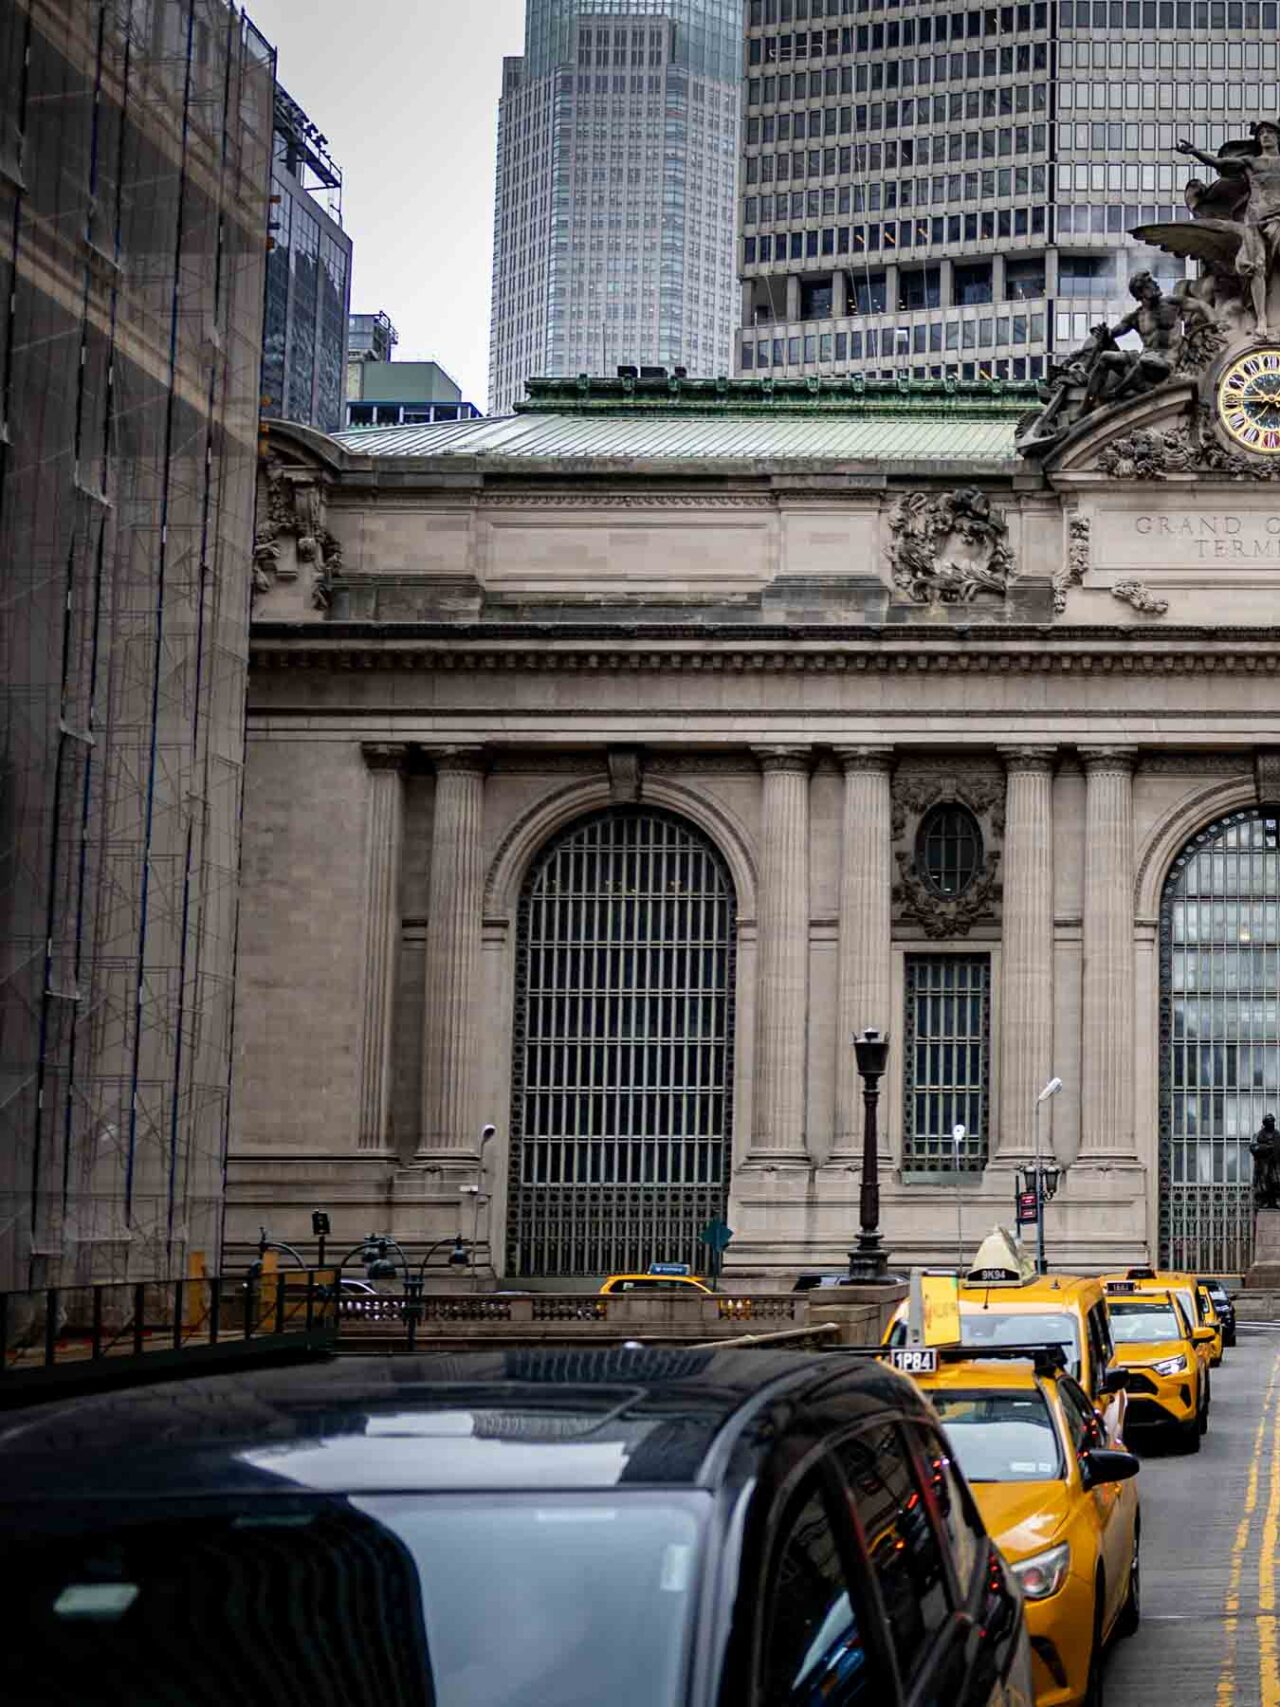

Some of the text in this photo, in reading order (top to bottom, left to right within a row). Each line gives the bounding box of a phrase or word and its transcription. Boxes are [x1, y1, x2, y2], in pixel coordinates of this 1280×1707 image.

[1136, 516, 1242, 535] GRAND
[982, 1270, 1006, 1280] 9K94
[895, 1352, 931, 1370] 1P84
